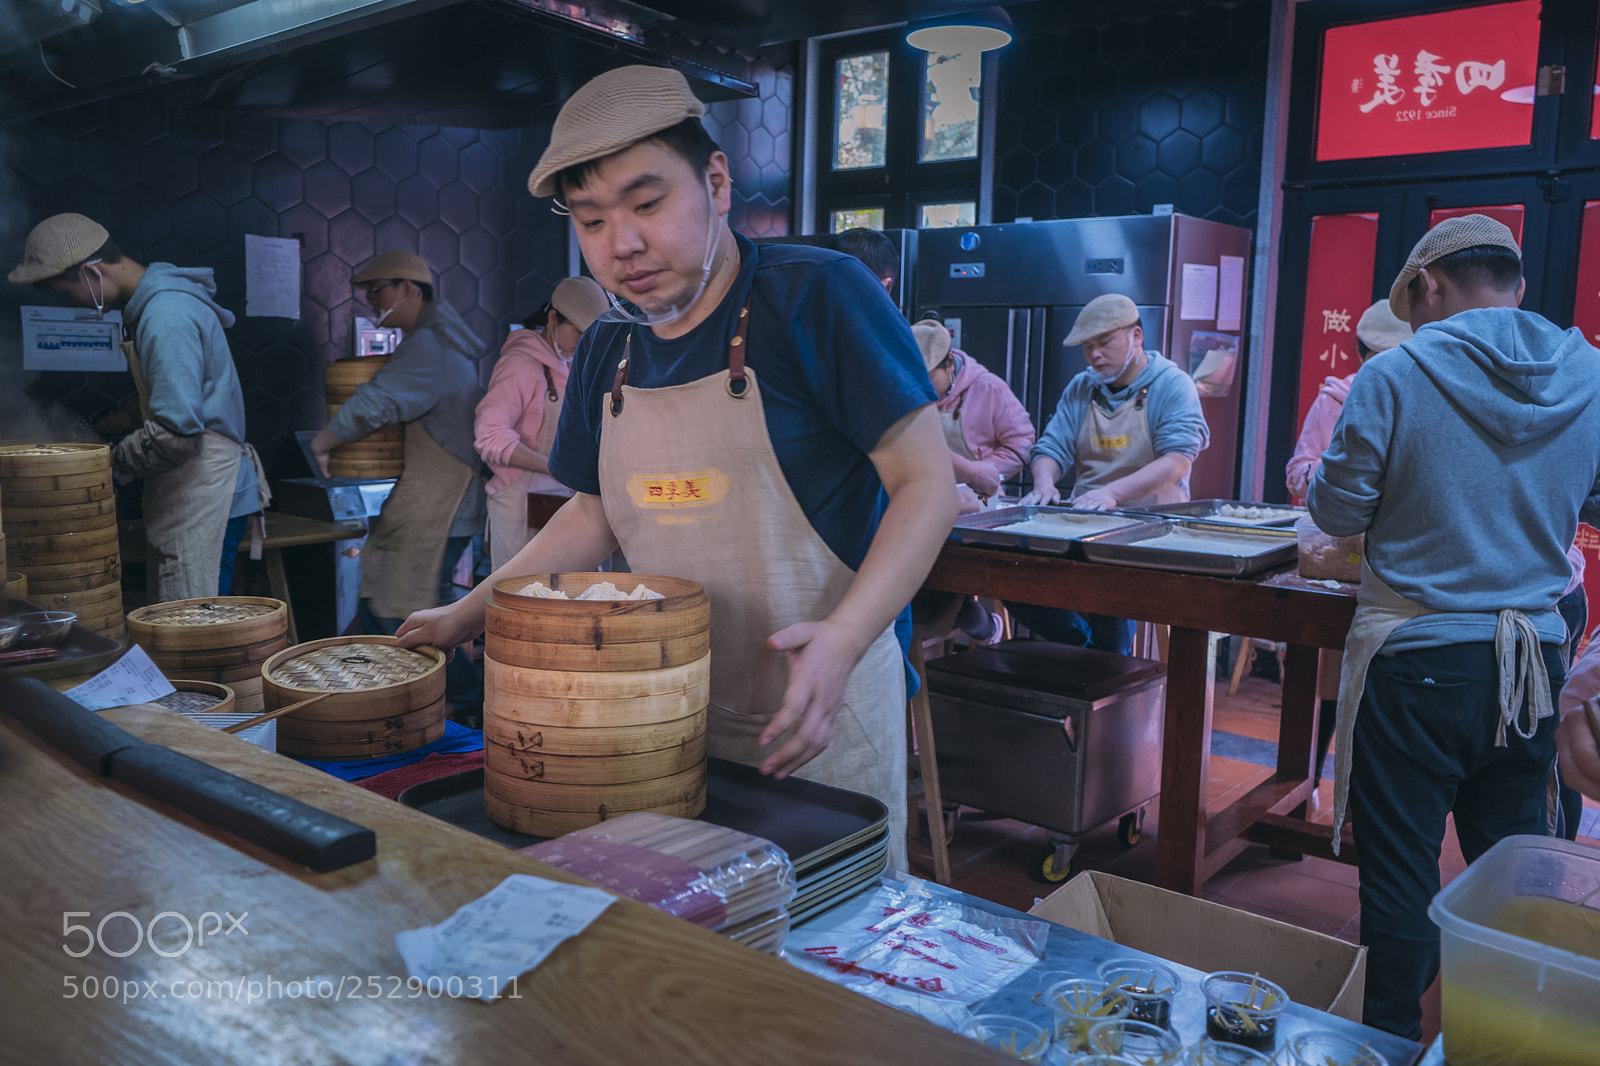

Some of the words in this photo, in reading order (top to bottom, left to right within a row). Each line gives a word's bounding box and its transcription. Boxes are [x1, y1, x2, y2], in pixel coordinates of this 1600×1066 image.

[1319, 308, 1352, 391] 做小
[648, 480, 701, 500] 四季美
